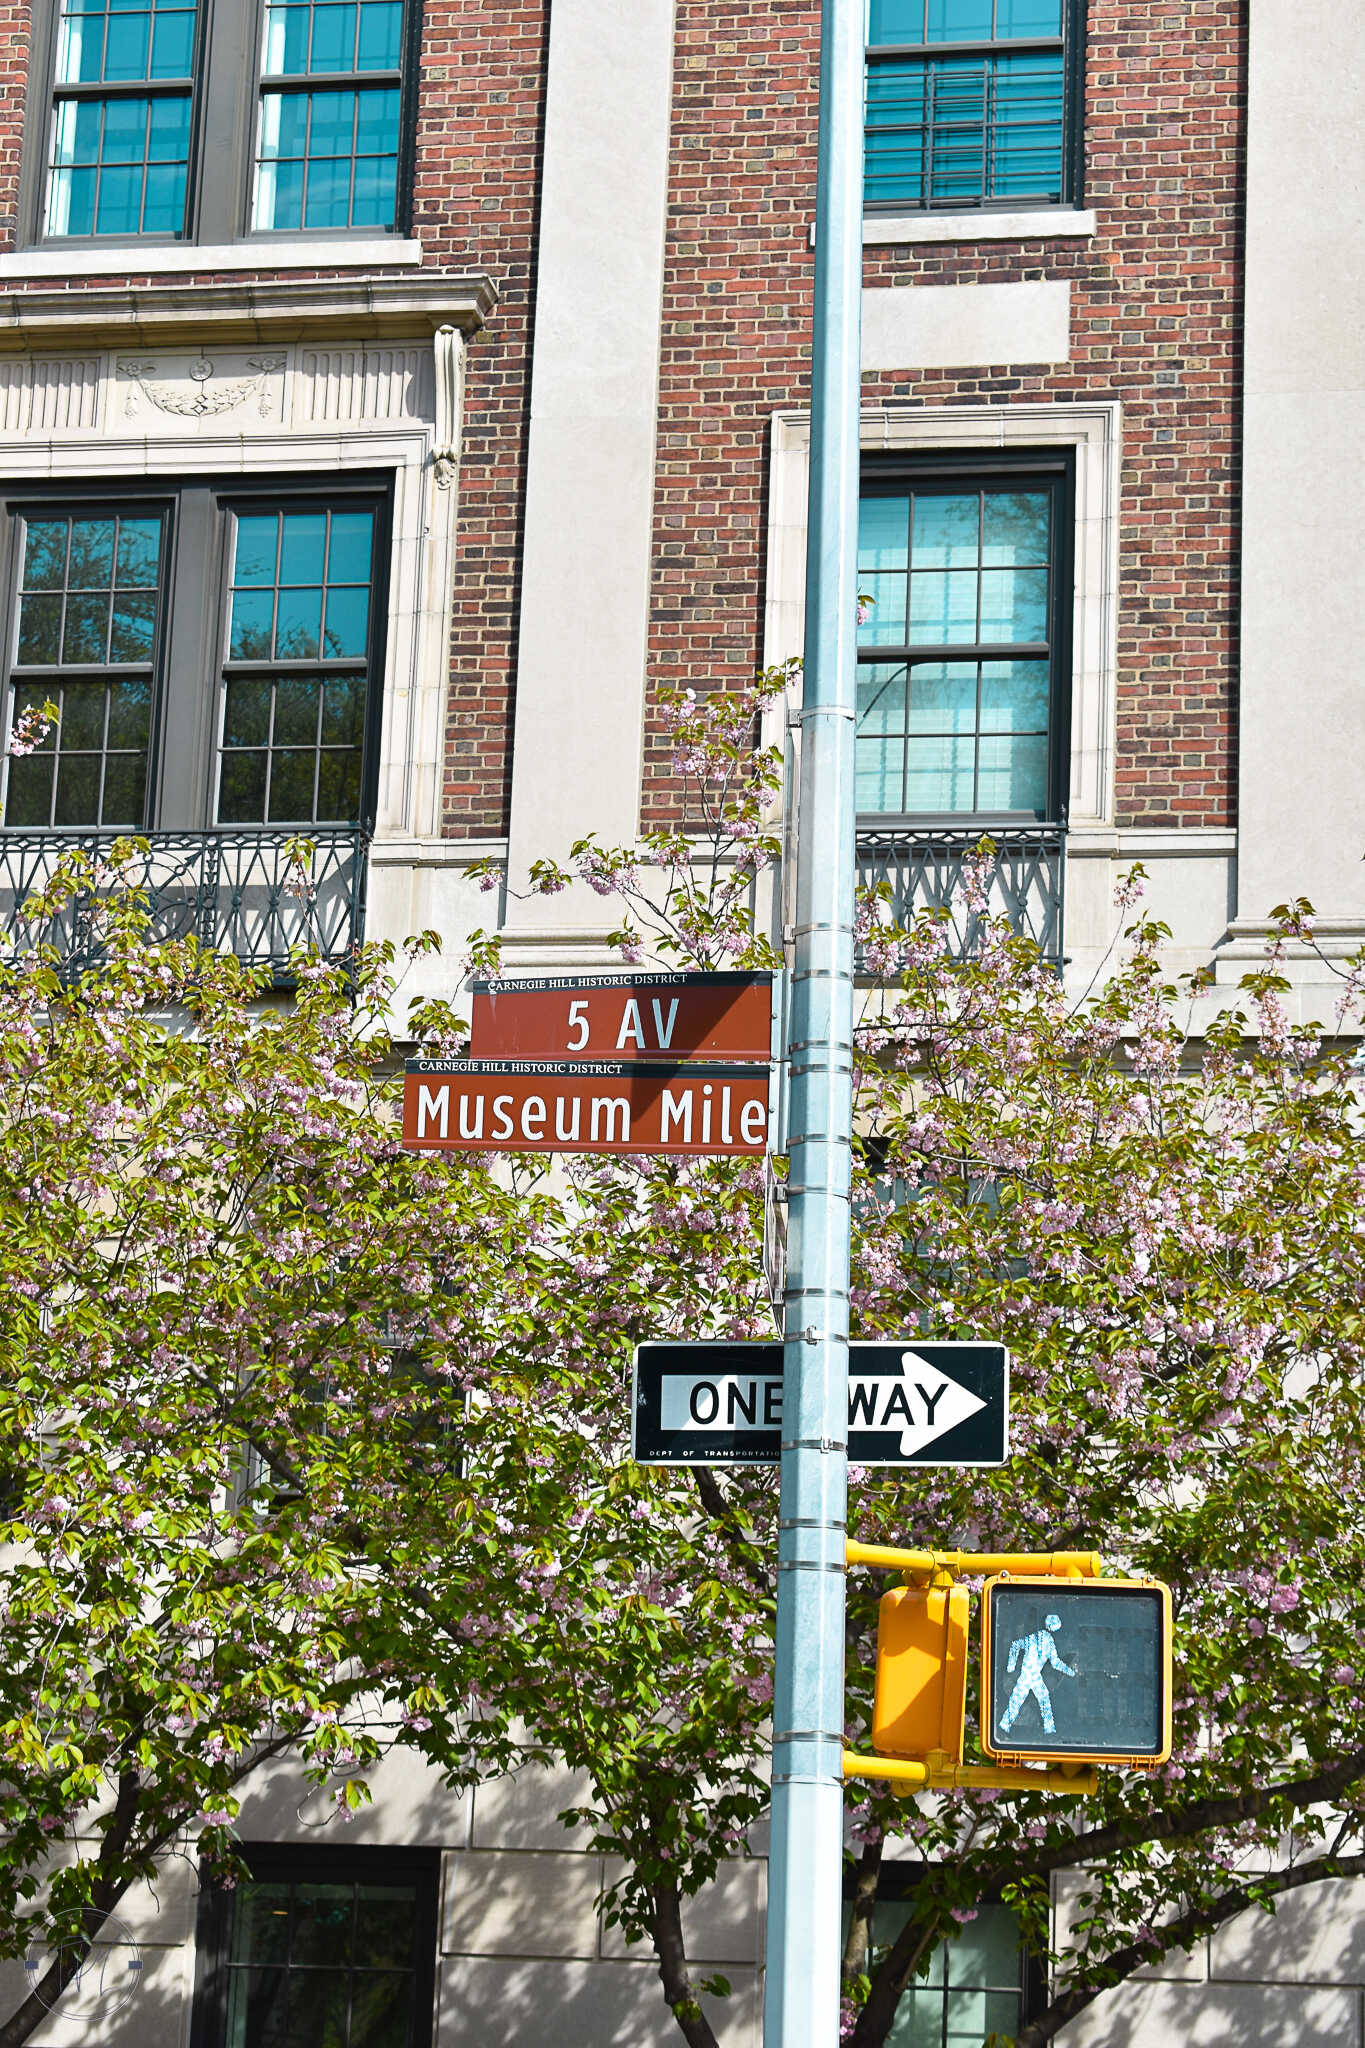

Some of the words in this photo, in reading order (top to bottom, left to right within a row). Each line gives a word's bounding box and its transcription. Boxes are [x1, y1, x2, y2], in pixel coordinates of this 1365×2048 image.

[488, 980, 546, 991] CARNEGIE
[549, 979, 575, 989] HILL
[578, 976, 631, 987] HISTORIC
[634, 974, 687, 984] DISTRICT
[566, 1000, 590, 1051] 5
[616, 998, 680, 1049] AV
[419, 1061, 479, 1072] CARNEGIE
[481, 1062, 508, 1072] HILL
[511, 1064, 566, 1074] HISTORIC
[568, 1064, 622, 1075] DISTRICT
[417, 1084, 631, 1142] Museum
[660, 1083, 766, 1145] Mile
[689, 1381, 783, 1425] ONE
[848, 1383, 949, 1426] WAY
